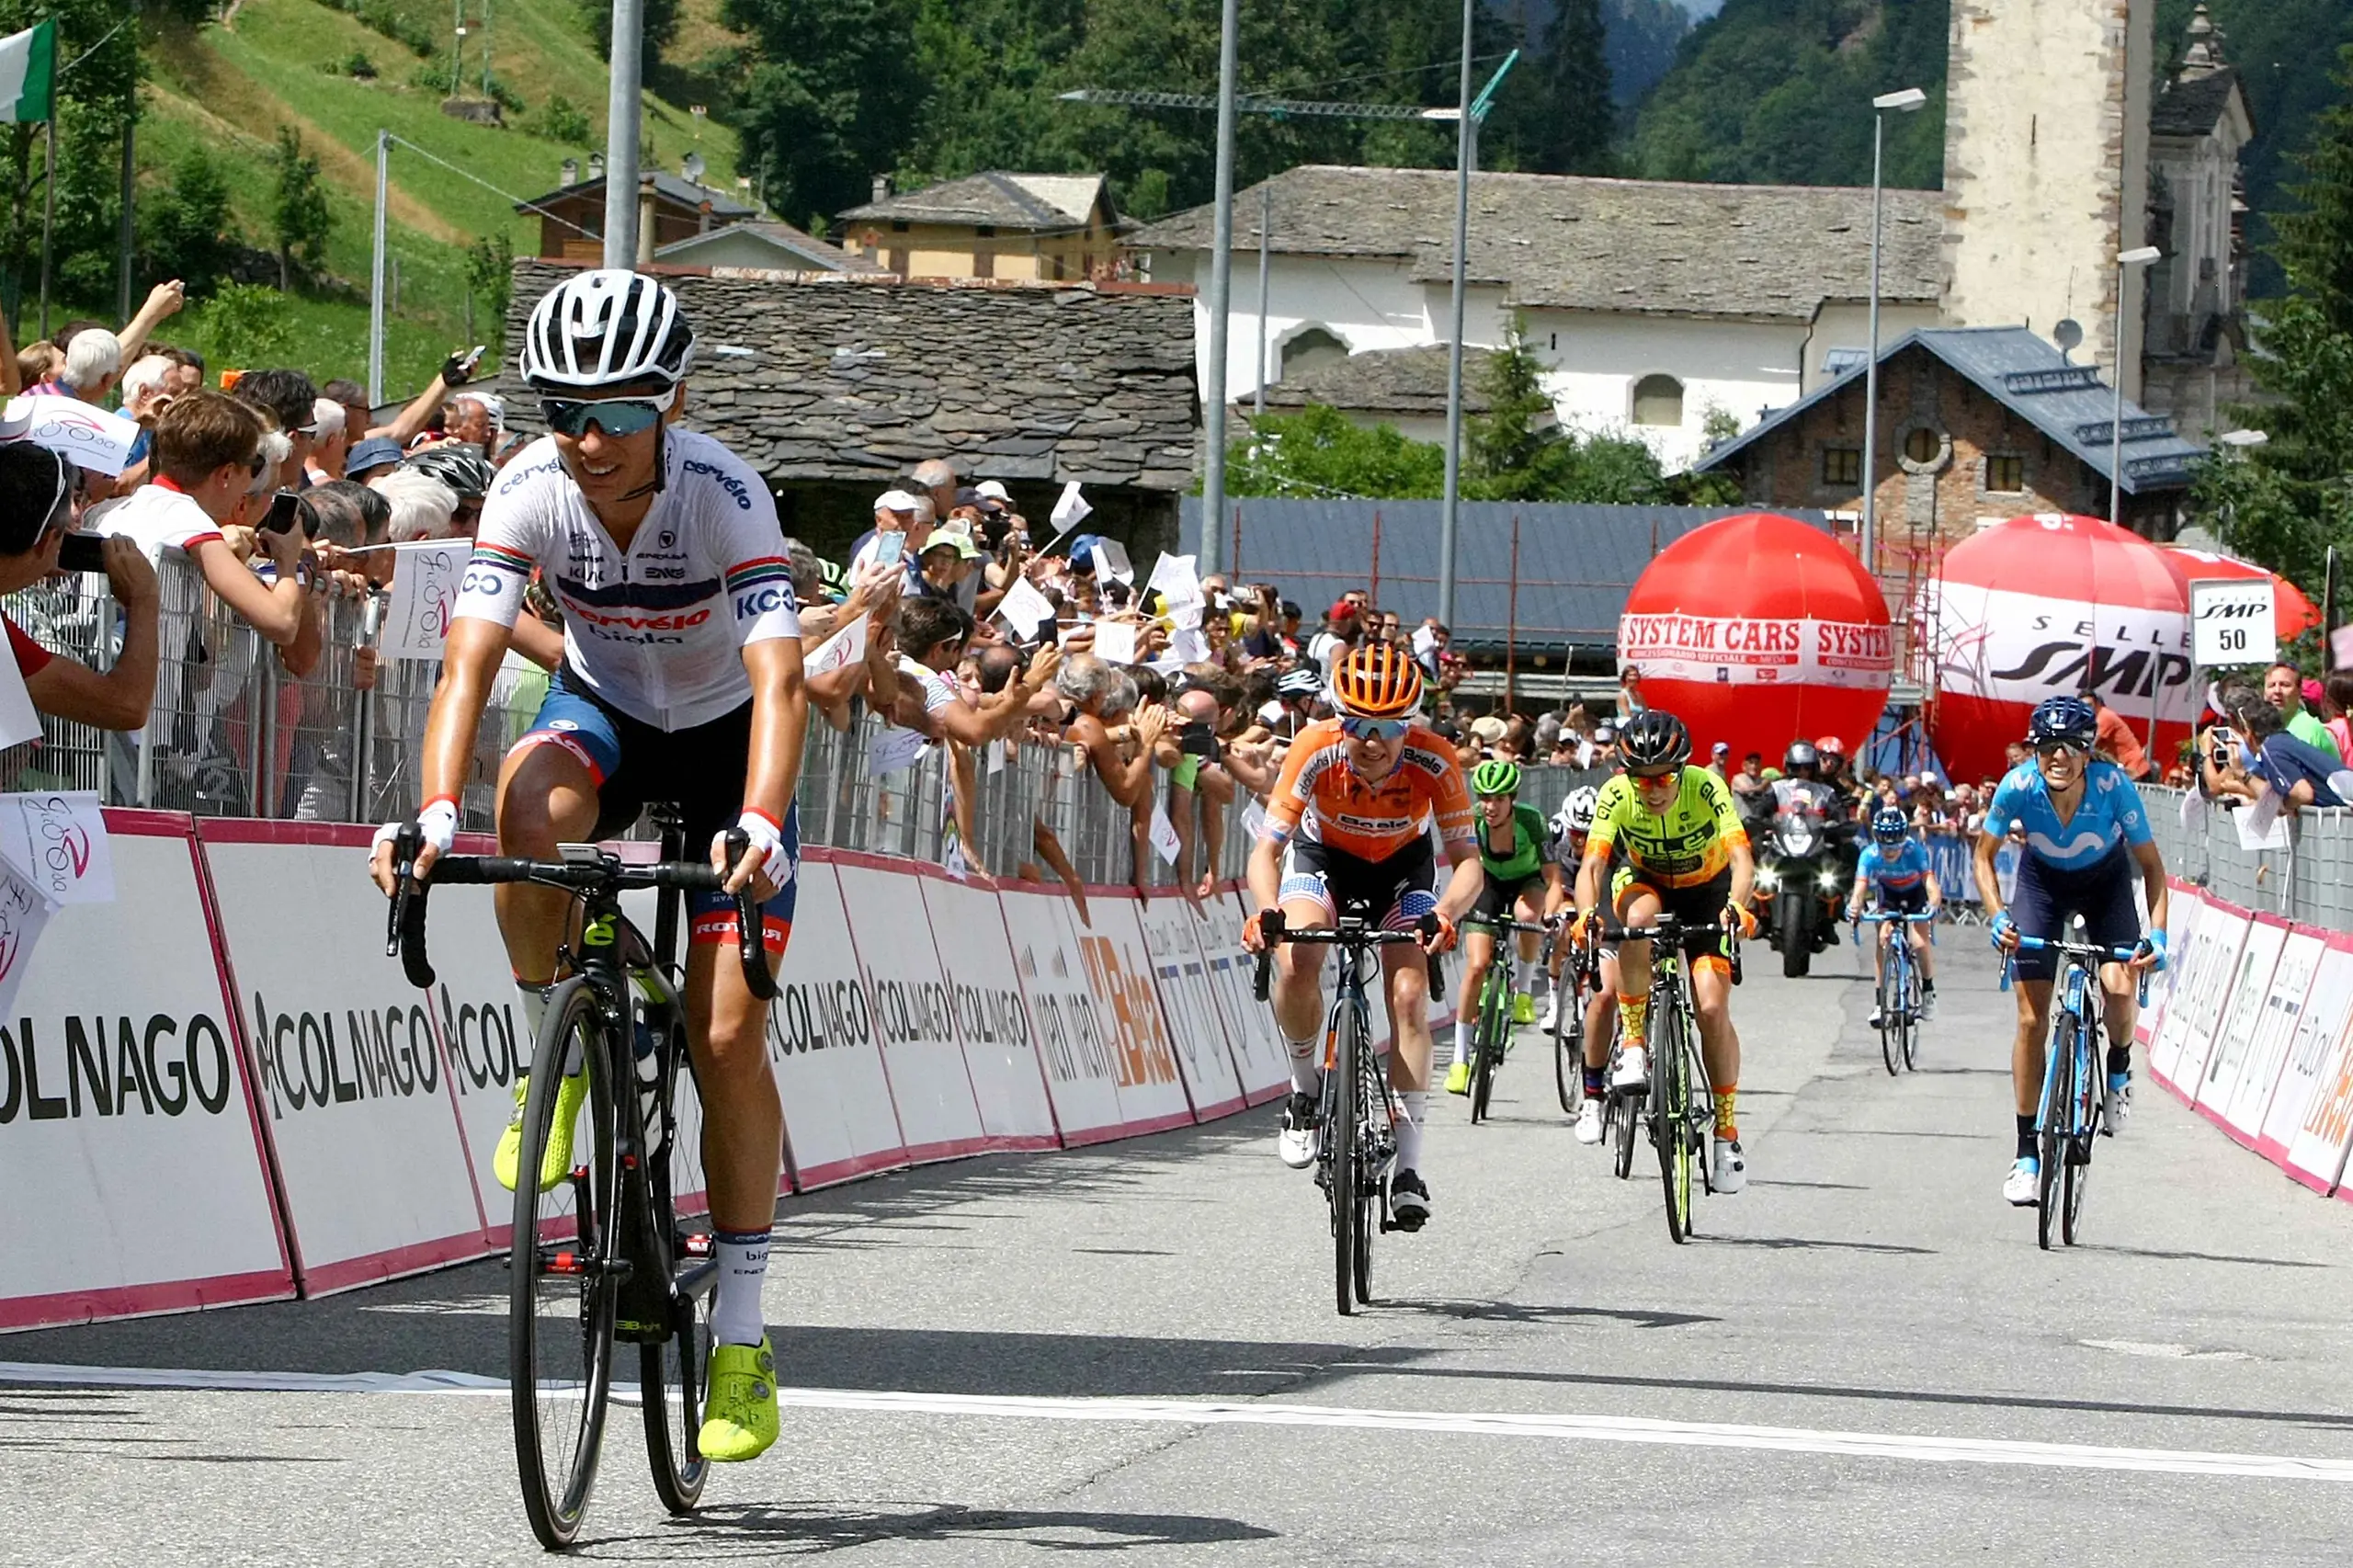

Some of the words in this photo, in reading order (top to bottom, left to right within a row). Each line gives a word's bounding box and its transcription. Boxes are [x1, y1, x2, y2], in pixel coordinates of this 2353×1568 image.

[683, 460, 751, 510] cervélo
[561, 596, 710, 630] cervélo
[2195, 604, 2268, 619] SMP
[1628, 616, 1717, 650] SYSTEM
[1724, 621, 1800, 652] CARS
[2032, 616, 2191, 648] SELLE
[2219, 629, 2245, 650] 50
[1698, 653, 1746, 664] UFFICIALE
[1991, 641, 2192, 698] SMP
[1404, 747, 1442, 774] Boels
[772, 978, 869, 1057] COLNAGO
[876, 981, 953, 1046] COLNAGO
[954, 984, 1029, 1048] COLNAGO
[274, 1004, 438, 1111] COLNAGO
